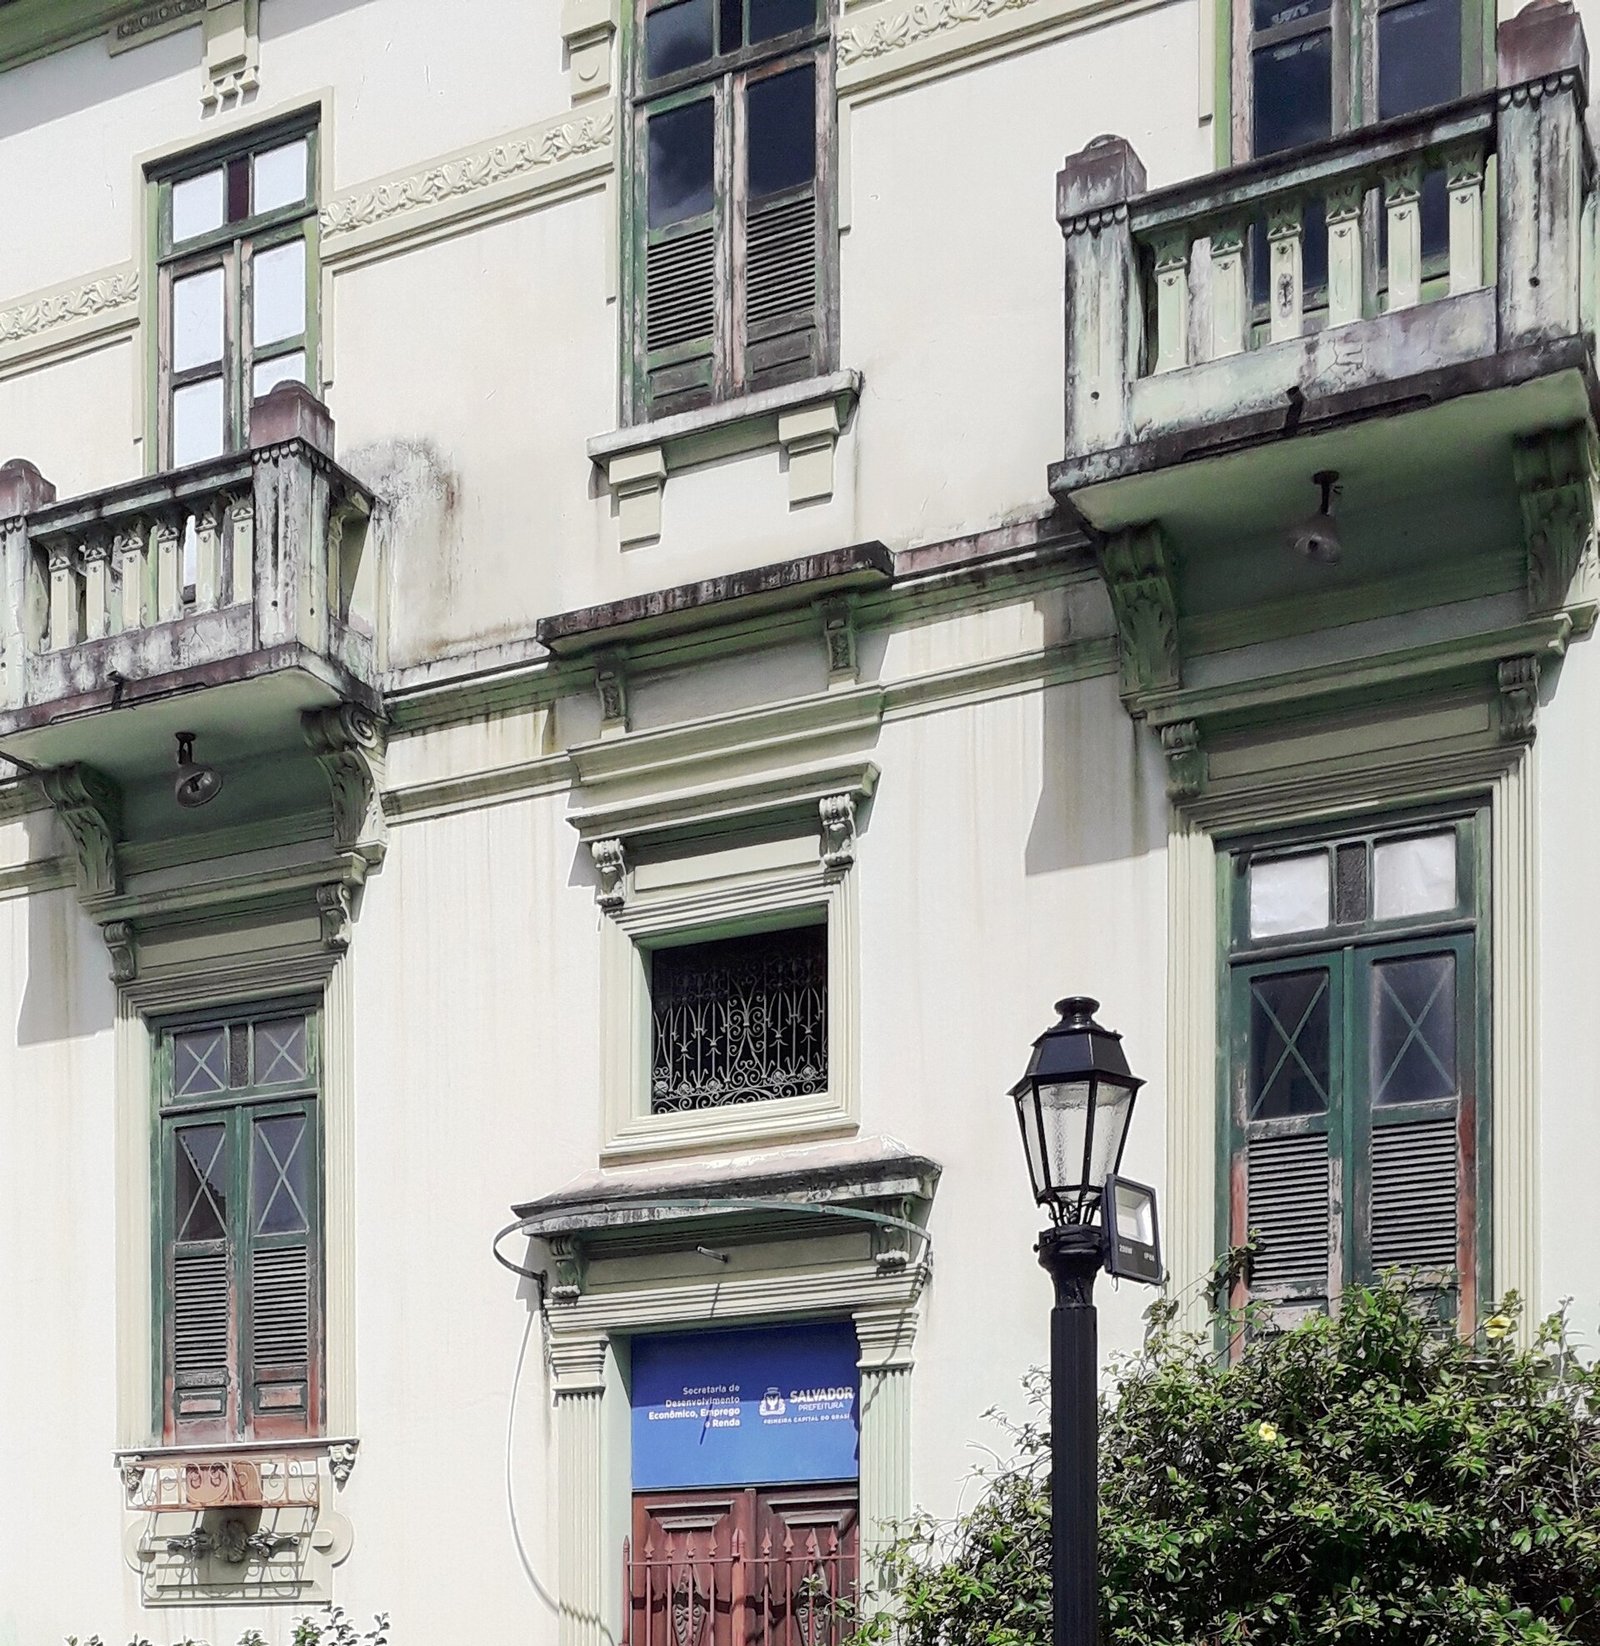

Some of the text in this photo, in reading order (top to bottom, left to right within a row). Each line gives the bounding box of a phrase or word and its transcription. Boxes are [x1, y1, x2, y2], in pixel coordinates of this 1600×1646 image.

[683, 1383, 740, 1395] Secretaria de
[790, 1387, 853, 1403] SALVADOR
[665, 1396, 740, 1408] Desenvolvimento
[798, 1401, 844, 1412] PREFEITURA
[648, 1407, 740, 1420] Econômico, Emprego
[705, 1418, 740, 1428] e Renda
[763, 1417, 792, 1425] PRIMEIRA
[793, 1415, 818, 1423] CAPITAL
